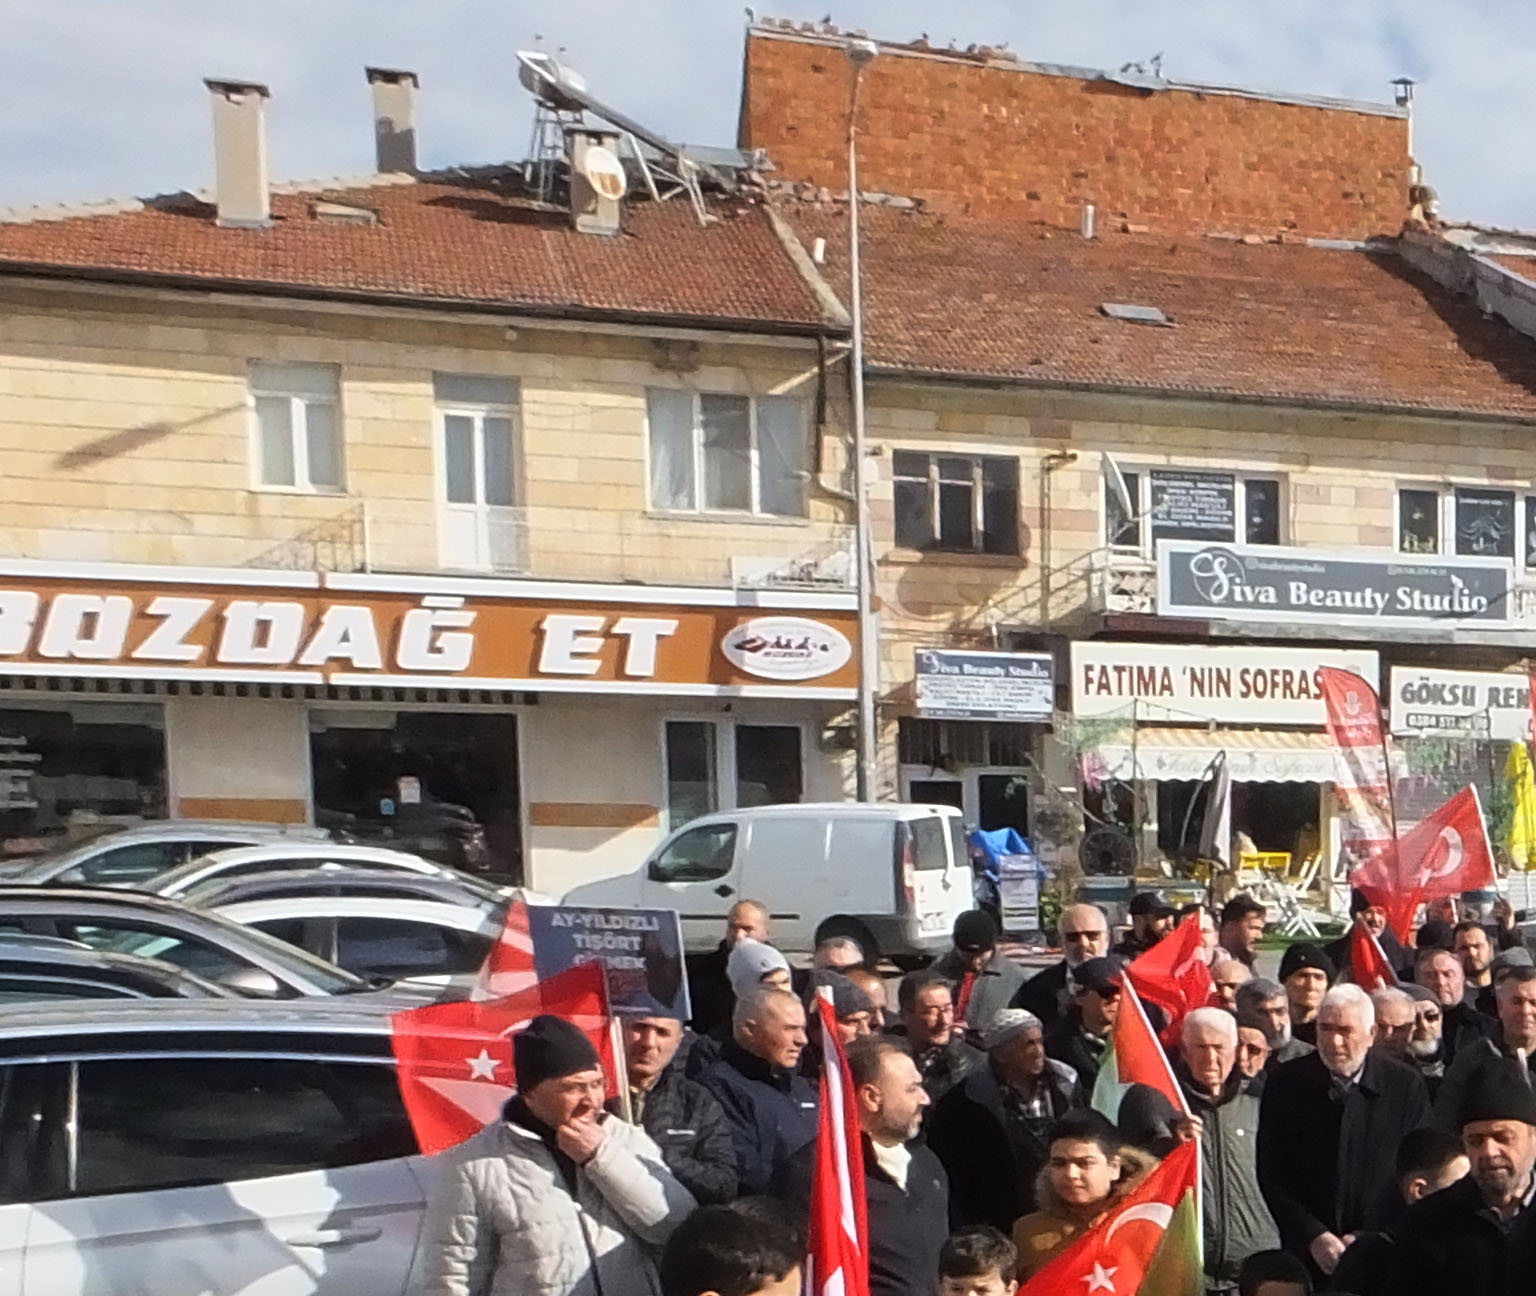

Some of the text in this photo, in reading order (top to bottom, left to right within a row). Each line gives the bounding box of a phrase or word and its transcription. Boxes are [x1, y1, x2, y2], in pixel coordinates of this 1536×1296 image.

[1288, 581, 1390, 616] Beauty
[1396, 574, 1488, 613] Studio
[540, 613, 679, 677] ET
[1084, 664, 1174, 697] FATIMA
[1240, 667, 1324, 700] SOFRAS
[1401, 676, 1476, 707] GÖKSU
[1487, 686, 1531, 709] REN
